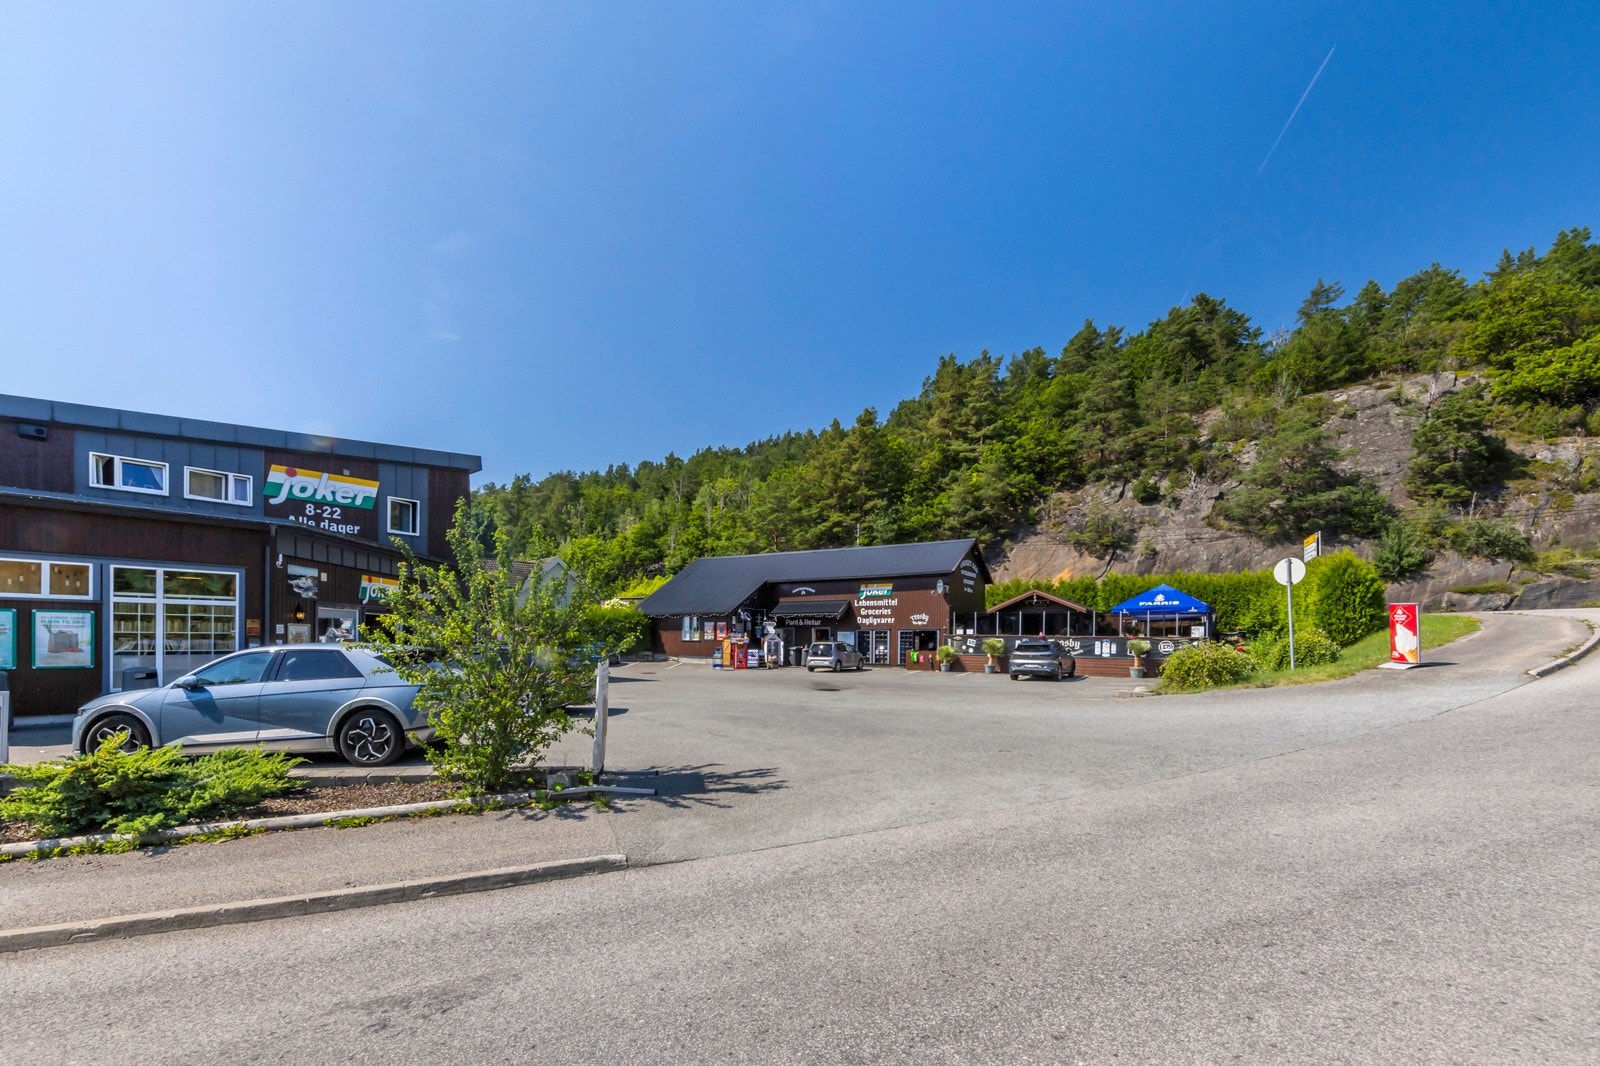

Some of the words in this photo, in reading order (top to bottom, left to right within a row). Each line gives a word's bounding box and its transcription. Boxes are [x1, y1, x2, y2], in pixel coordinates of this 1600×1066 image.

[269, 467, 372, 505] joker
[305, 503, 342, 519] 8-22
[320, 519, 361, 534] dager
[859, 584, 888, 600] joker
[854, 598, 898, 607] Lebensmittel
[857, 616, 895, 626] Dagligvarer
